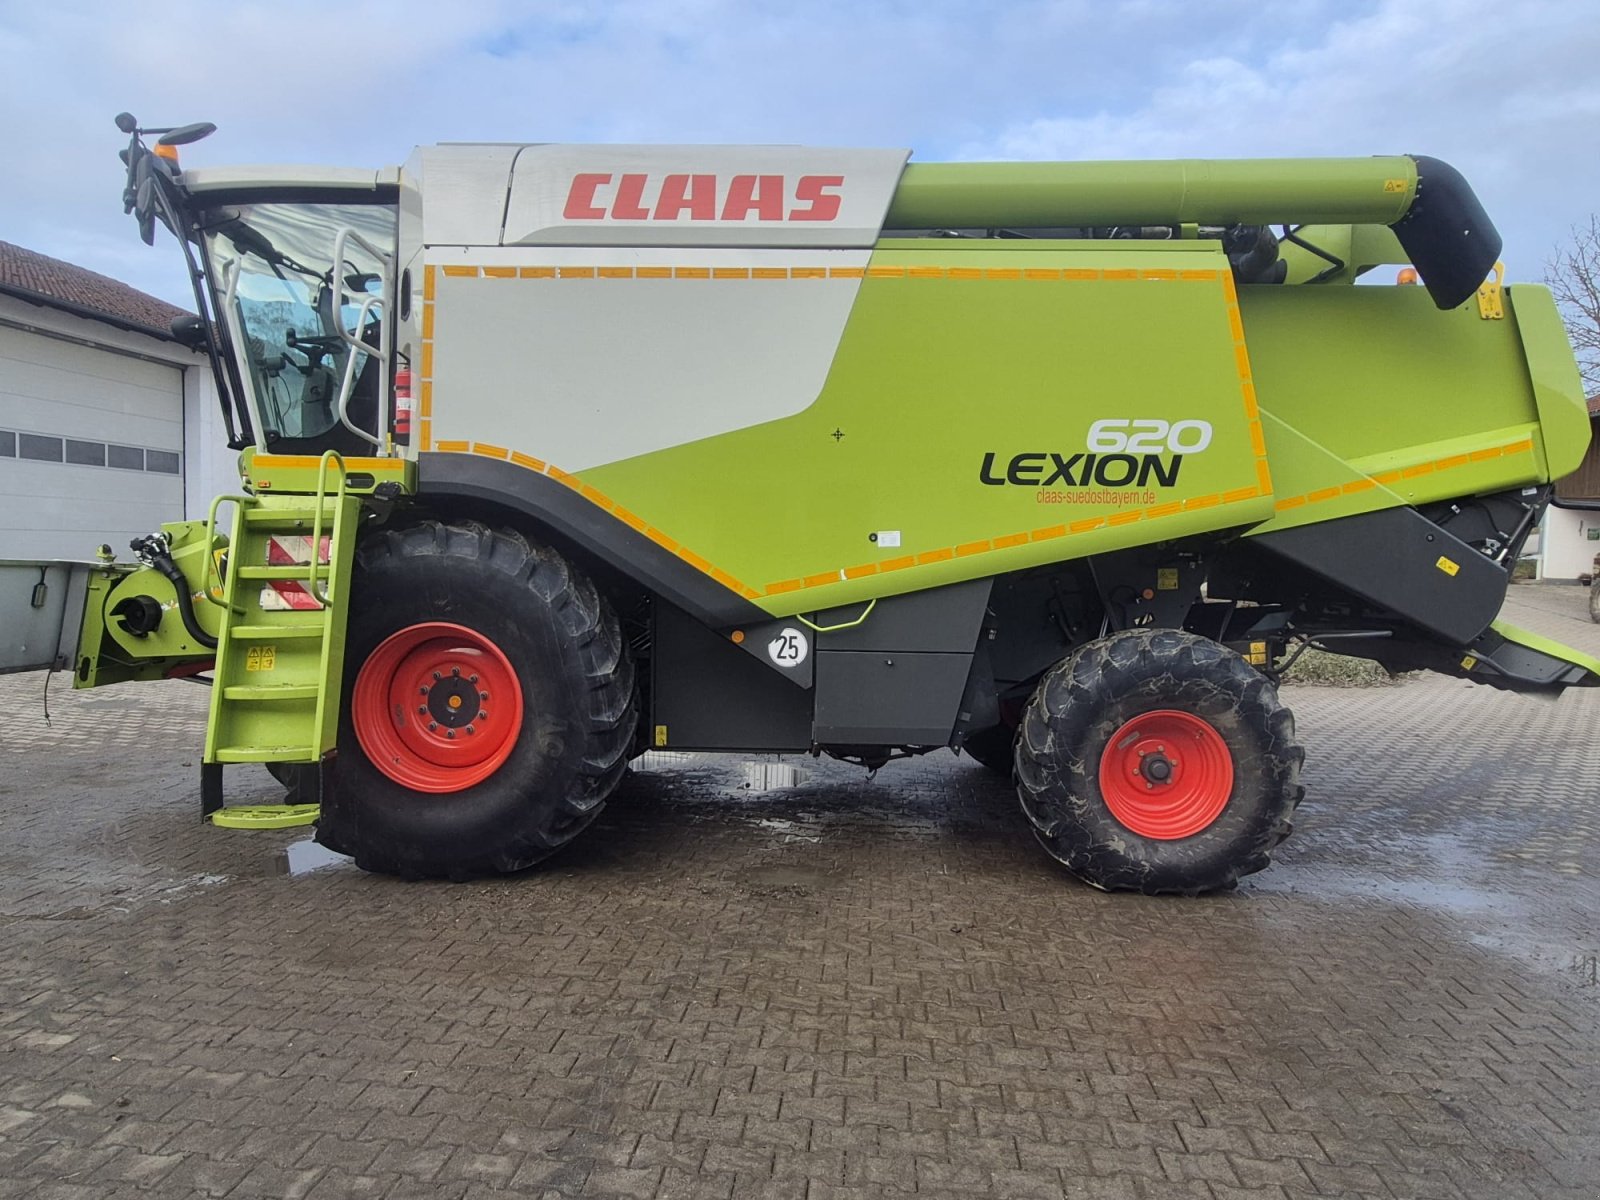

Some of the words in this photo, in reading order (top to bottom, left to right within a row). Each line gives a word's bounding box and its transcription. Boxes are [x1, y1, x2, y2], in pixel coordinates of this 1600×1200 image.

[563, 173, 845, 221] CLAAS
[1086, 419, 1213, 454] 620
[980, 452, 1183, 487] LEXION
[1036, 488, 1155, 507] claas-suedostbayern.de
[777, 636, 799, 659] 25
